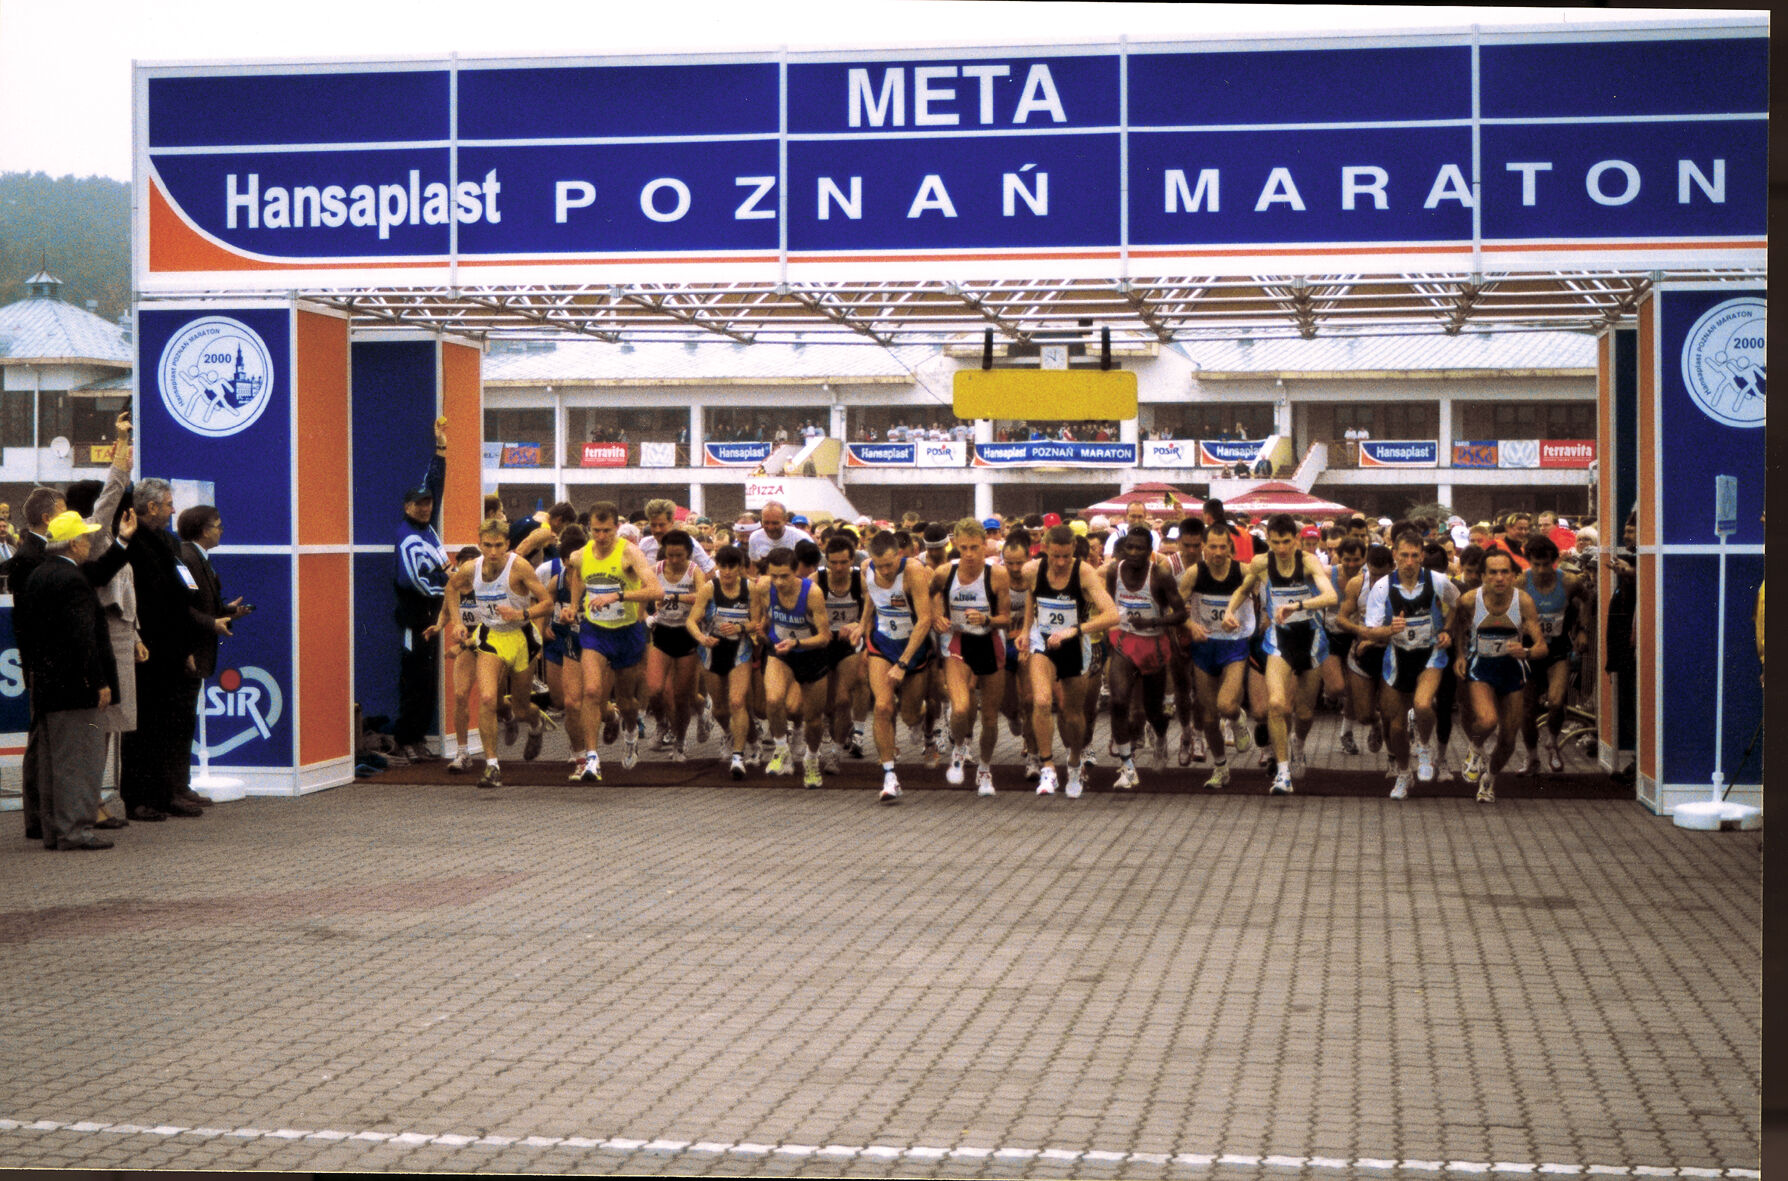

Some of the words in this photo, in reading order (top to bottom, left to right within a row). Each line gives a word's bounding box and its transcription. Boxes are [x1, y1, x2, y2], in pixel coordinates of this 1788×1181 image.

[848, 64, 1068, 127] META
[226, 168, 501, 239] Hansaplast
[555, 164, 1048, 223] POZNAŃ
[1165, 159, 1726, 213] MARATON
[1734, 337, 1765, 349] 2000
[203, 353, 232, 364] 2000
[584, 445, 626, 458] terravita
[719, 446, 765, 461] Hansaplast
[861, 447, 909, 461] Hansaplast
[983, 446, 1027, 460] Hansaplast
[1081, 448, 1132, 459] MARATON
[1376, 446, 1430, 460] Hansaplast
[1543, 443, 1593, 457] terravita
[752, 484, 785, 495] PIZZA
[665, 600, 679, 611] 28
[1049, 612, 1065, 625] 29
[889, 620, 898, 631] 8
[1407, 629, 1416, 641] 9
[1495, 642, 1503, 653] 7
